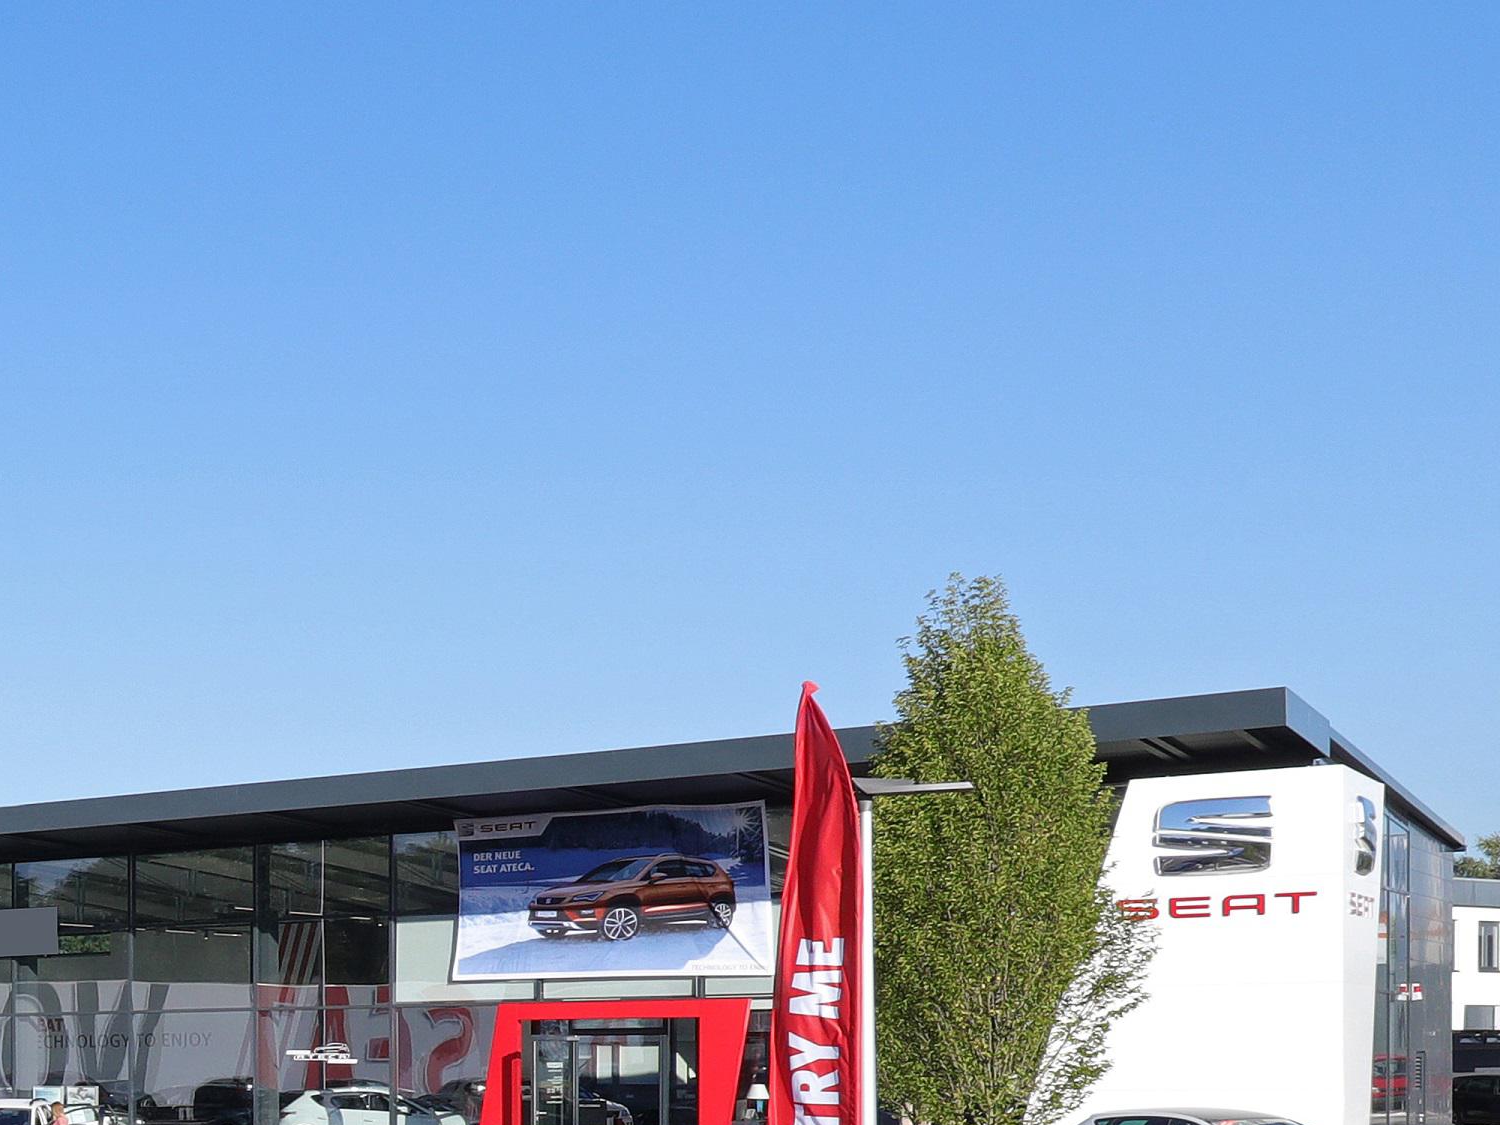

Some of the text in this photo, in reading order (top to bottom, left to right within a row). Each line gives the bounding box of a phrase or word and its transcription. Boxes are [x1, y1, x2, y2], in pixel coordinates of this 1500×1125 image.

[481, 821, 537, 833] SEAT
[473, 850, 521, 862] DER NEUE
[473, 862, 535, 874] SEAT ATECA.
[1116, 891, 1317, 920] SEAT
[789, 937, 844, 1019] ME
[162, 1031, 212, 1048] ENJOY
